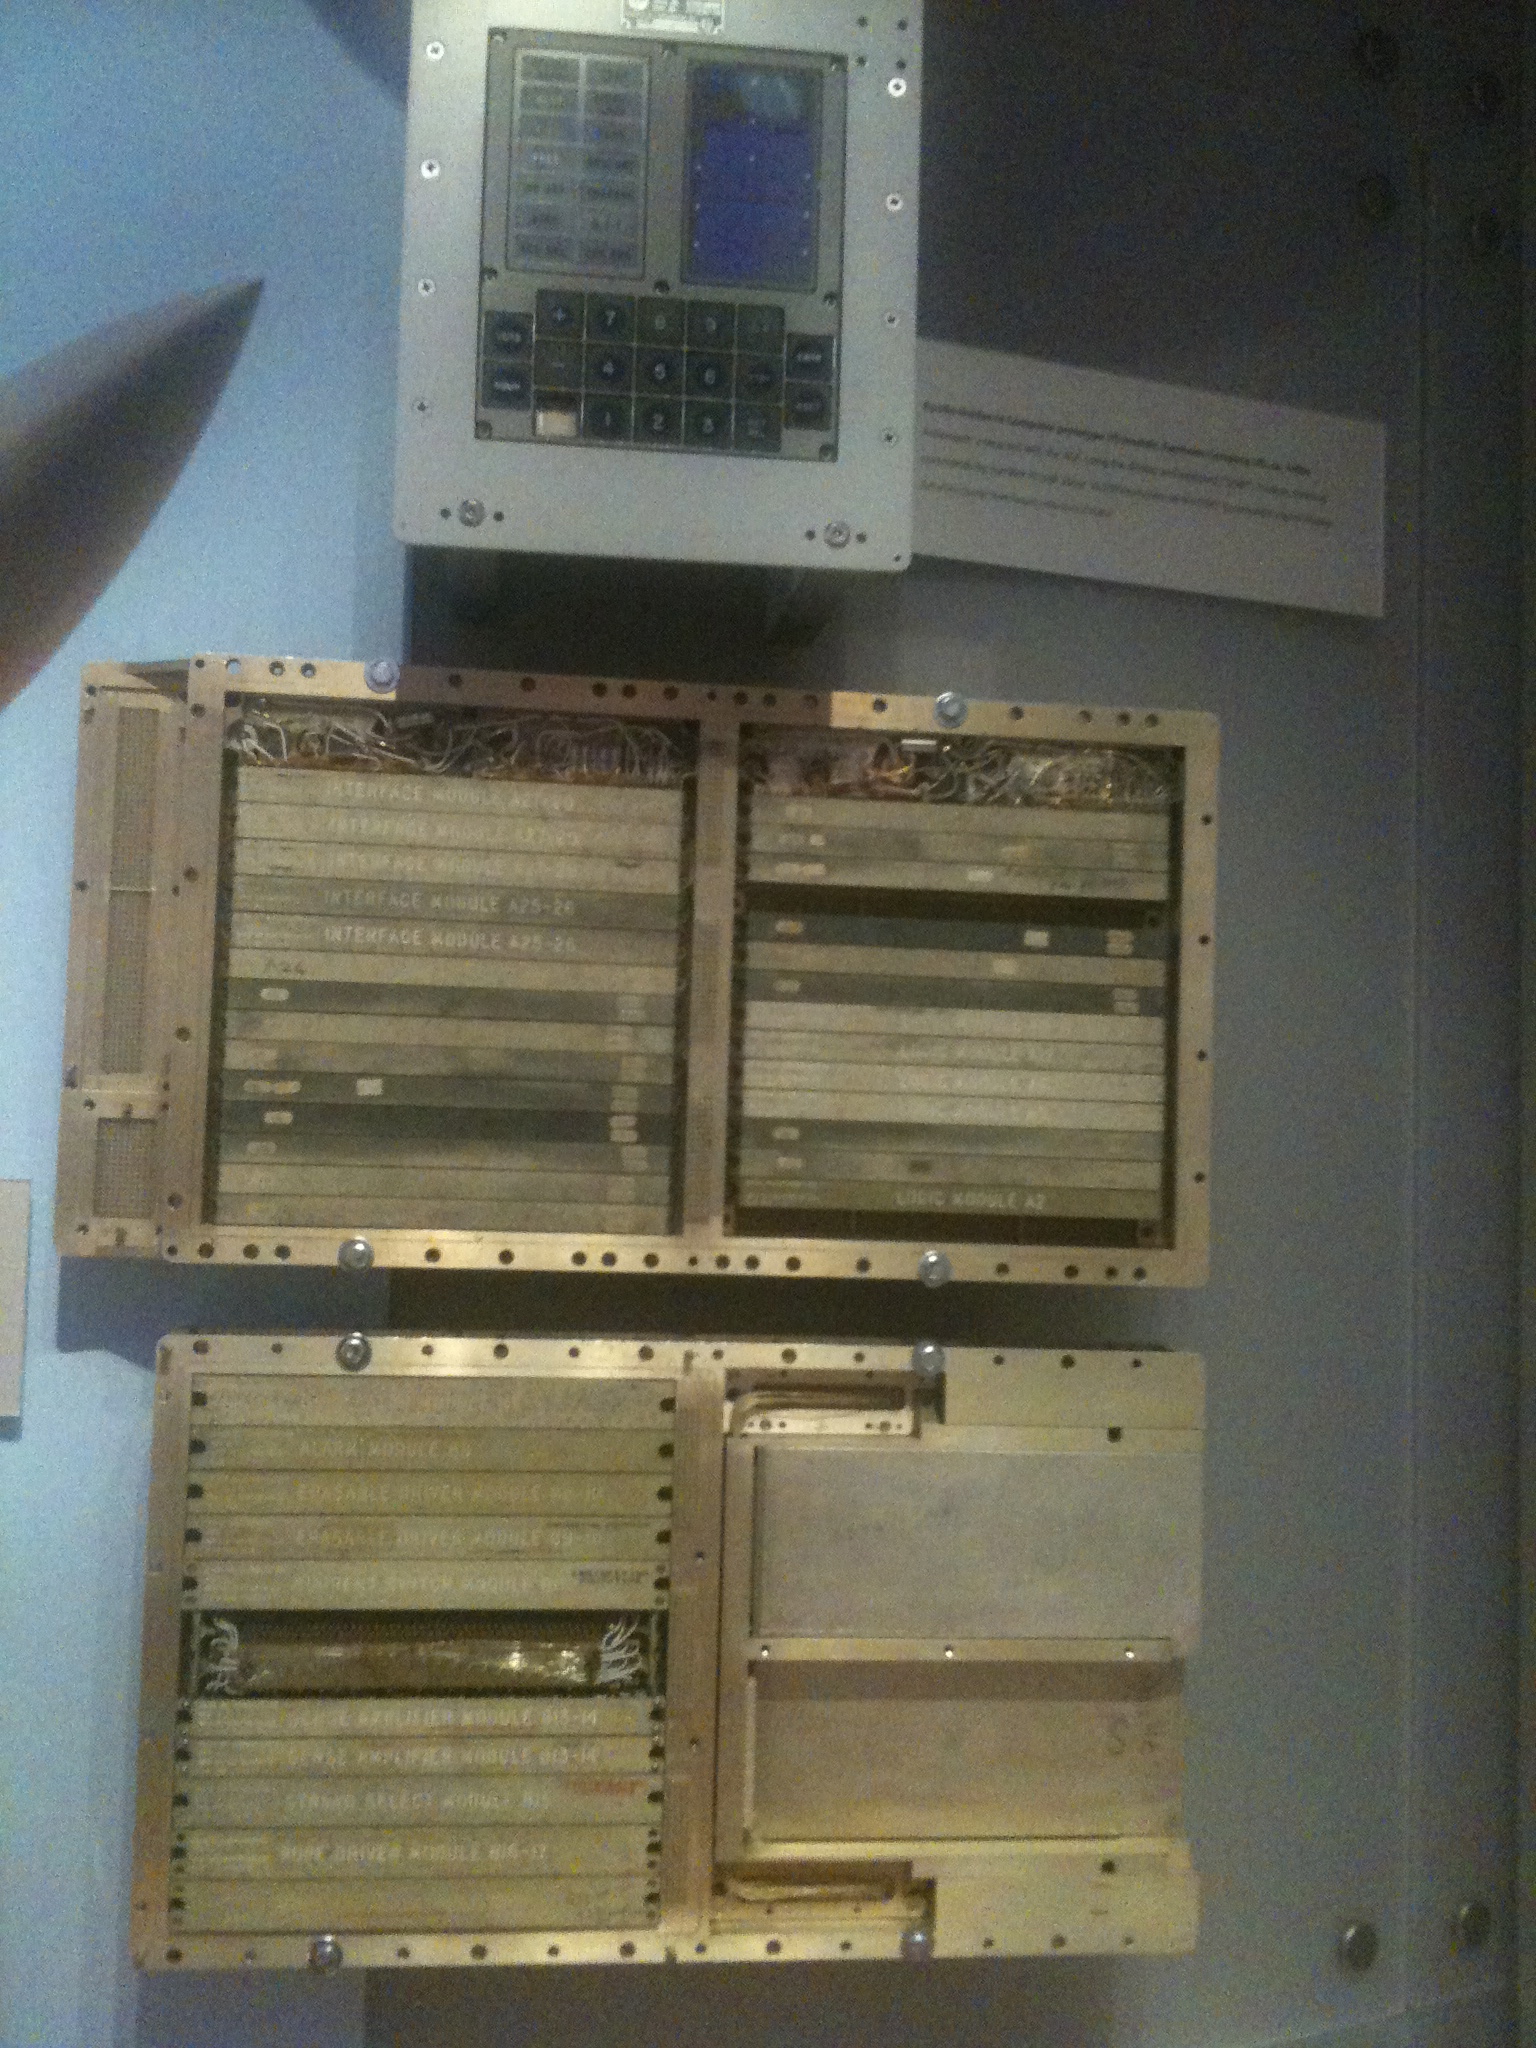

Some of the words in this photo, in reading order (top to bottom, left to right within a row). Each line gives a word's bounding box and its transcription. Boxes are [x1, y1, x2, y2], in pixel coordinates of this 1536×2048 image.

[605, 309, 617, 326] 7
[652, 412, 665, 432] 2
[323, 888, 423, 908] INTERFACE
[430, 893, 499, 913] MODULE
[323, 925, 423, 946] INTERFACE
[430, 931, 501, 950] MODULE
[952, 1192, 1018, 1210] MODULE
